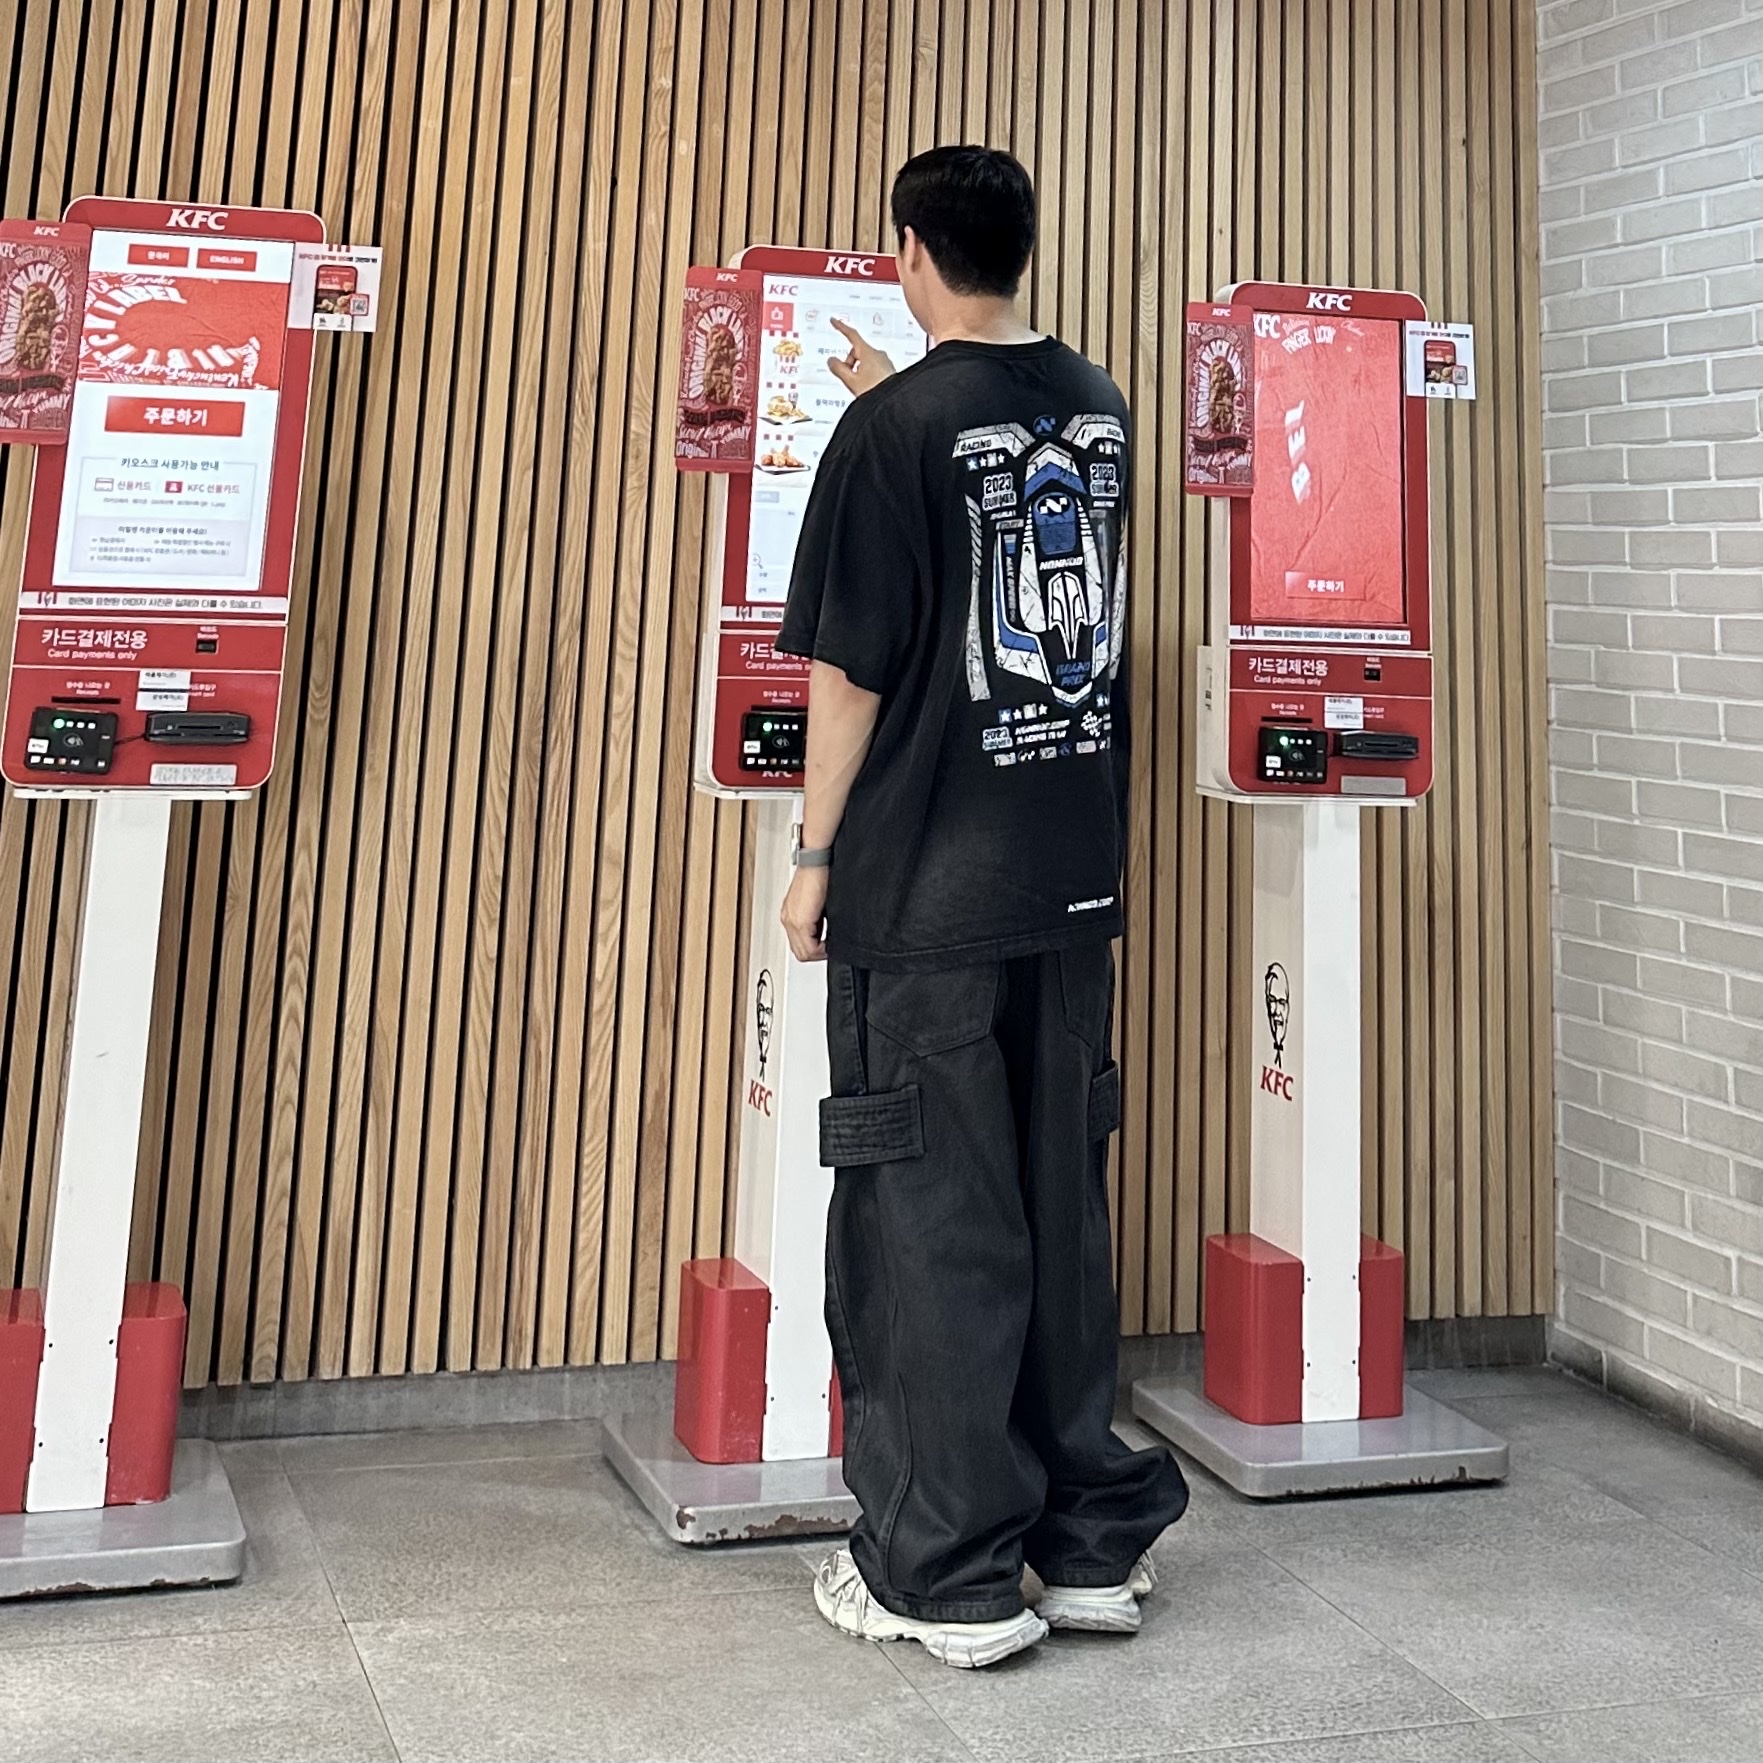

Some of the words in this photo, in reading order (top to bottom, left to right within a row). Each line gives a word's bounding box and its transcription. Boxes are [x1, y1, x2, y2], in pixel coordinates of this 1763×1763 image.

[166, 208, 228, 230] KFC
[34, 226, 60, 236] KFC
[210, 255, 245, 265] ENGLISH
[824, 256, 875, 275] KFC
[716, 273, 738, 282] KFC
[769, 284, 798, 296] KFC
[1306, 292, 1352, 311] KFC
[1212, 308, 1231, 316] KFC
[144, 407, 208, 427] 주문하기
[961, 439, 992, 452] RACING
[121, 458, 159, 469] 키오스크
[161, 459, 198, 470] 사용가능
[201, 461, 219, 471] 안내
[1091, 465, 1114, 481] 2023
[187, 484, 205, 493] KFC
[985, 476, 1012, 493] 2023
[984, 491, 1015, 509] SUMMER
[1307, 580, 1345, 593] 주문하기
[41, 628, 148, 649] 카드결제전용
[47, 649, 70, 659] Card
[72, 650, 116, 660] payments
[118, 651, 138, 661] only
[746, 661, 764, 670] Card
[766, 662, 803, 671] payments
[1249, 657, 1328, 677] 카드결제전용
[1254, 675, 1271, 684] Card
[1272, 677, 1305, 686] payments
[1307, 678, 1322, 687] only
[1260, 1065, 1294, 1101] KFC
[748, 1078, 773, 1118] KFC
